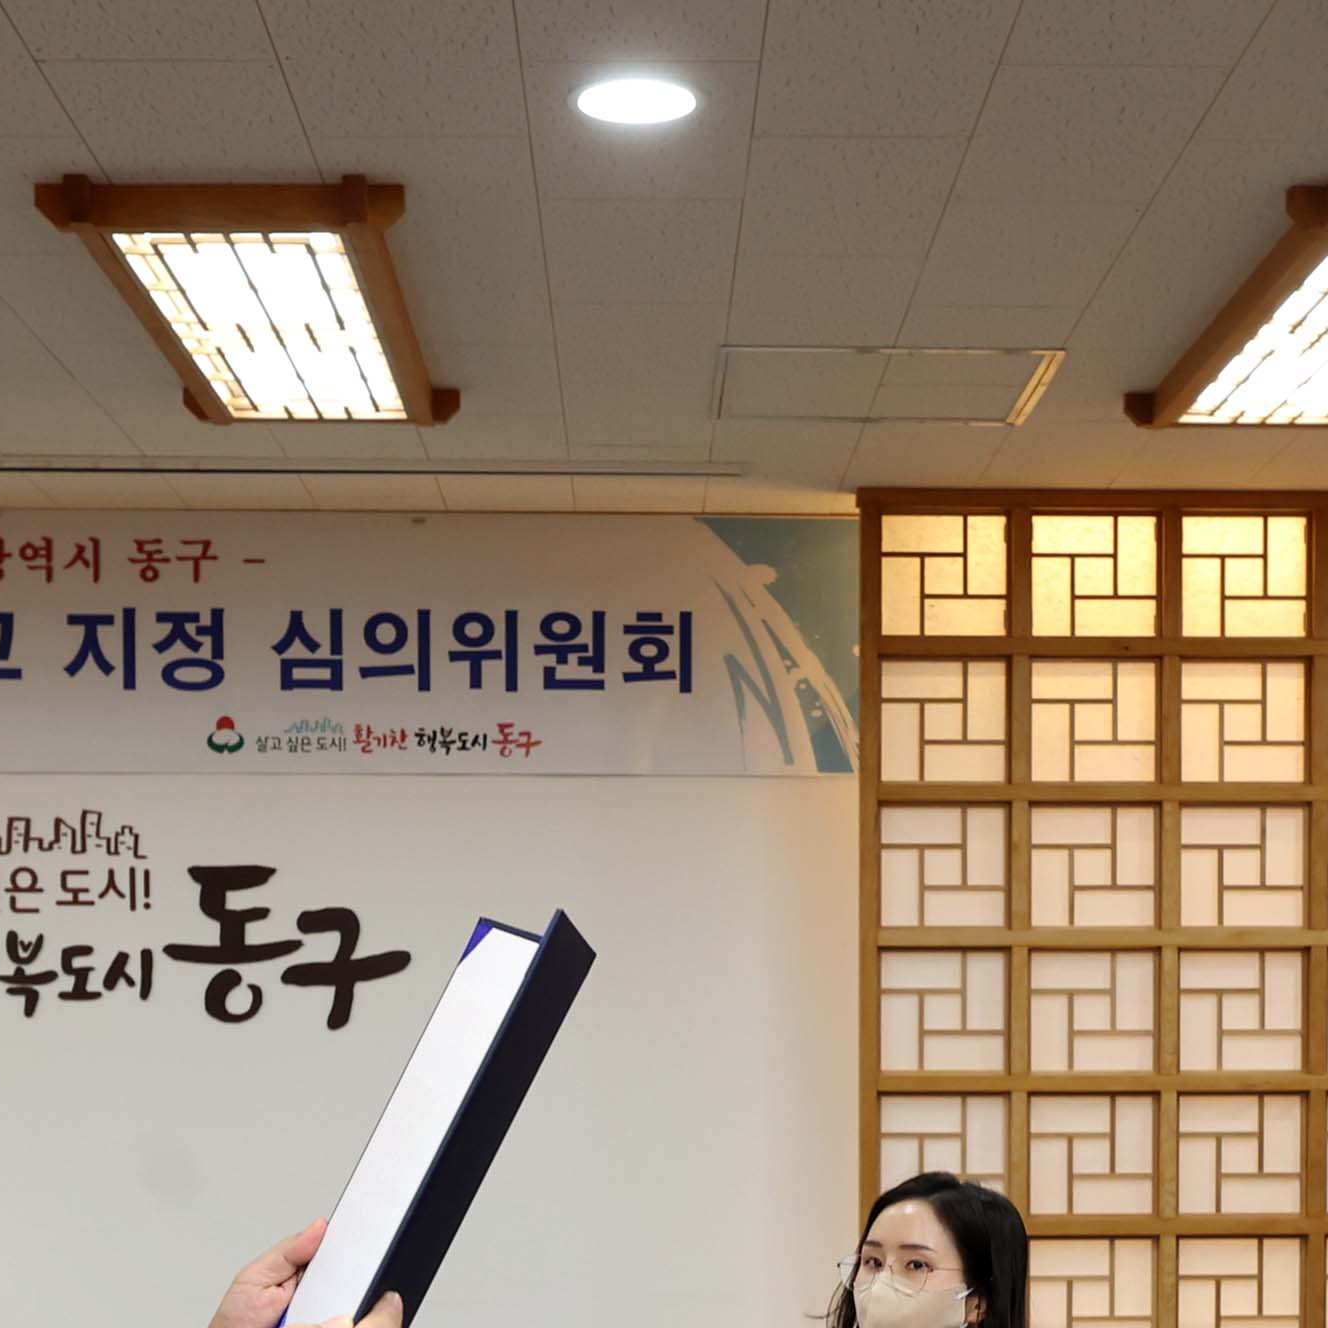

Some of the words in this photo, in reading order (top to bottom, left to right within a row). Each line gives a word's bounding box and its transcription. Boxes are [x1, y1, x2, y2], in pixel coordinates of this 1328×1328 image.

[127, 538, 219, 584] 동구
[63, 607, 226, 691] 지정
[271, 609, 694, 693] 심의위원회
[353, 724, 408, 754] 활기찬
[415, 727, 488, 756] 행복도시
[491, 722, 542, 758] 동구
[56, 866, 152, 912] 도시!
[162, 864, 412, 1030] 동구
